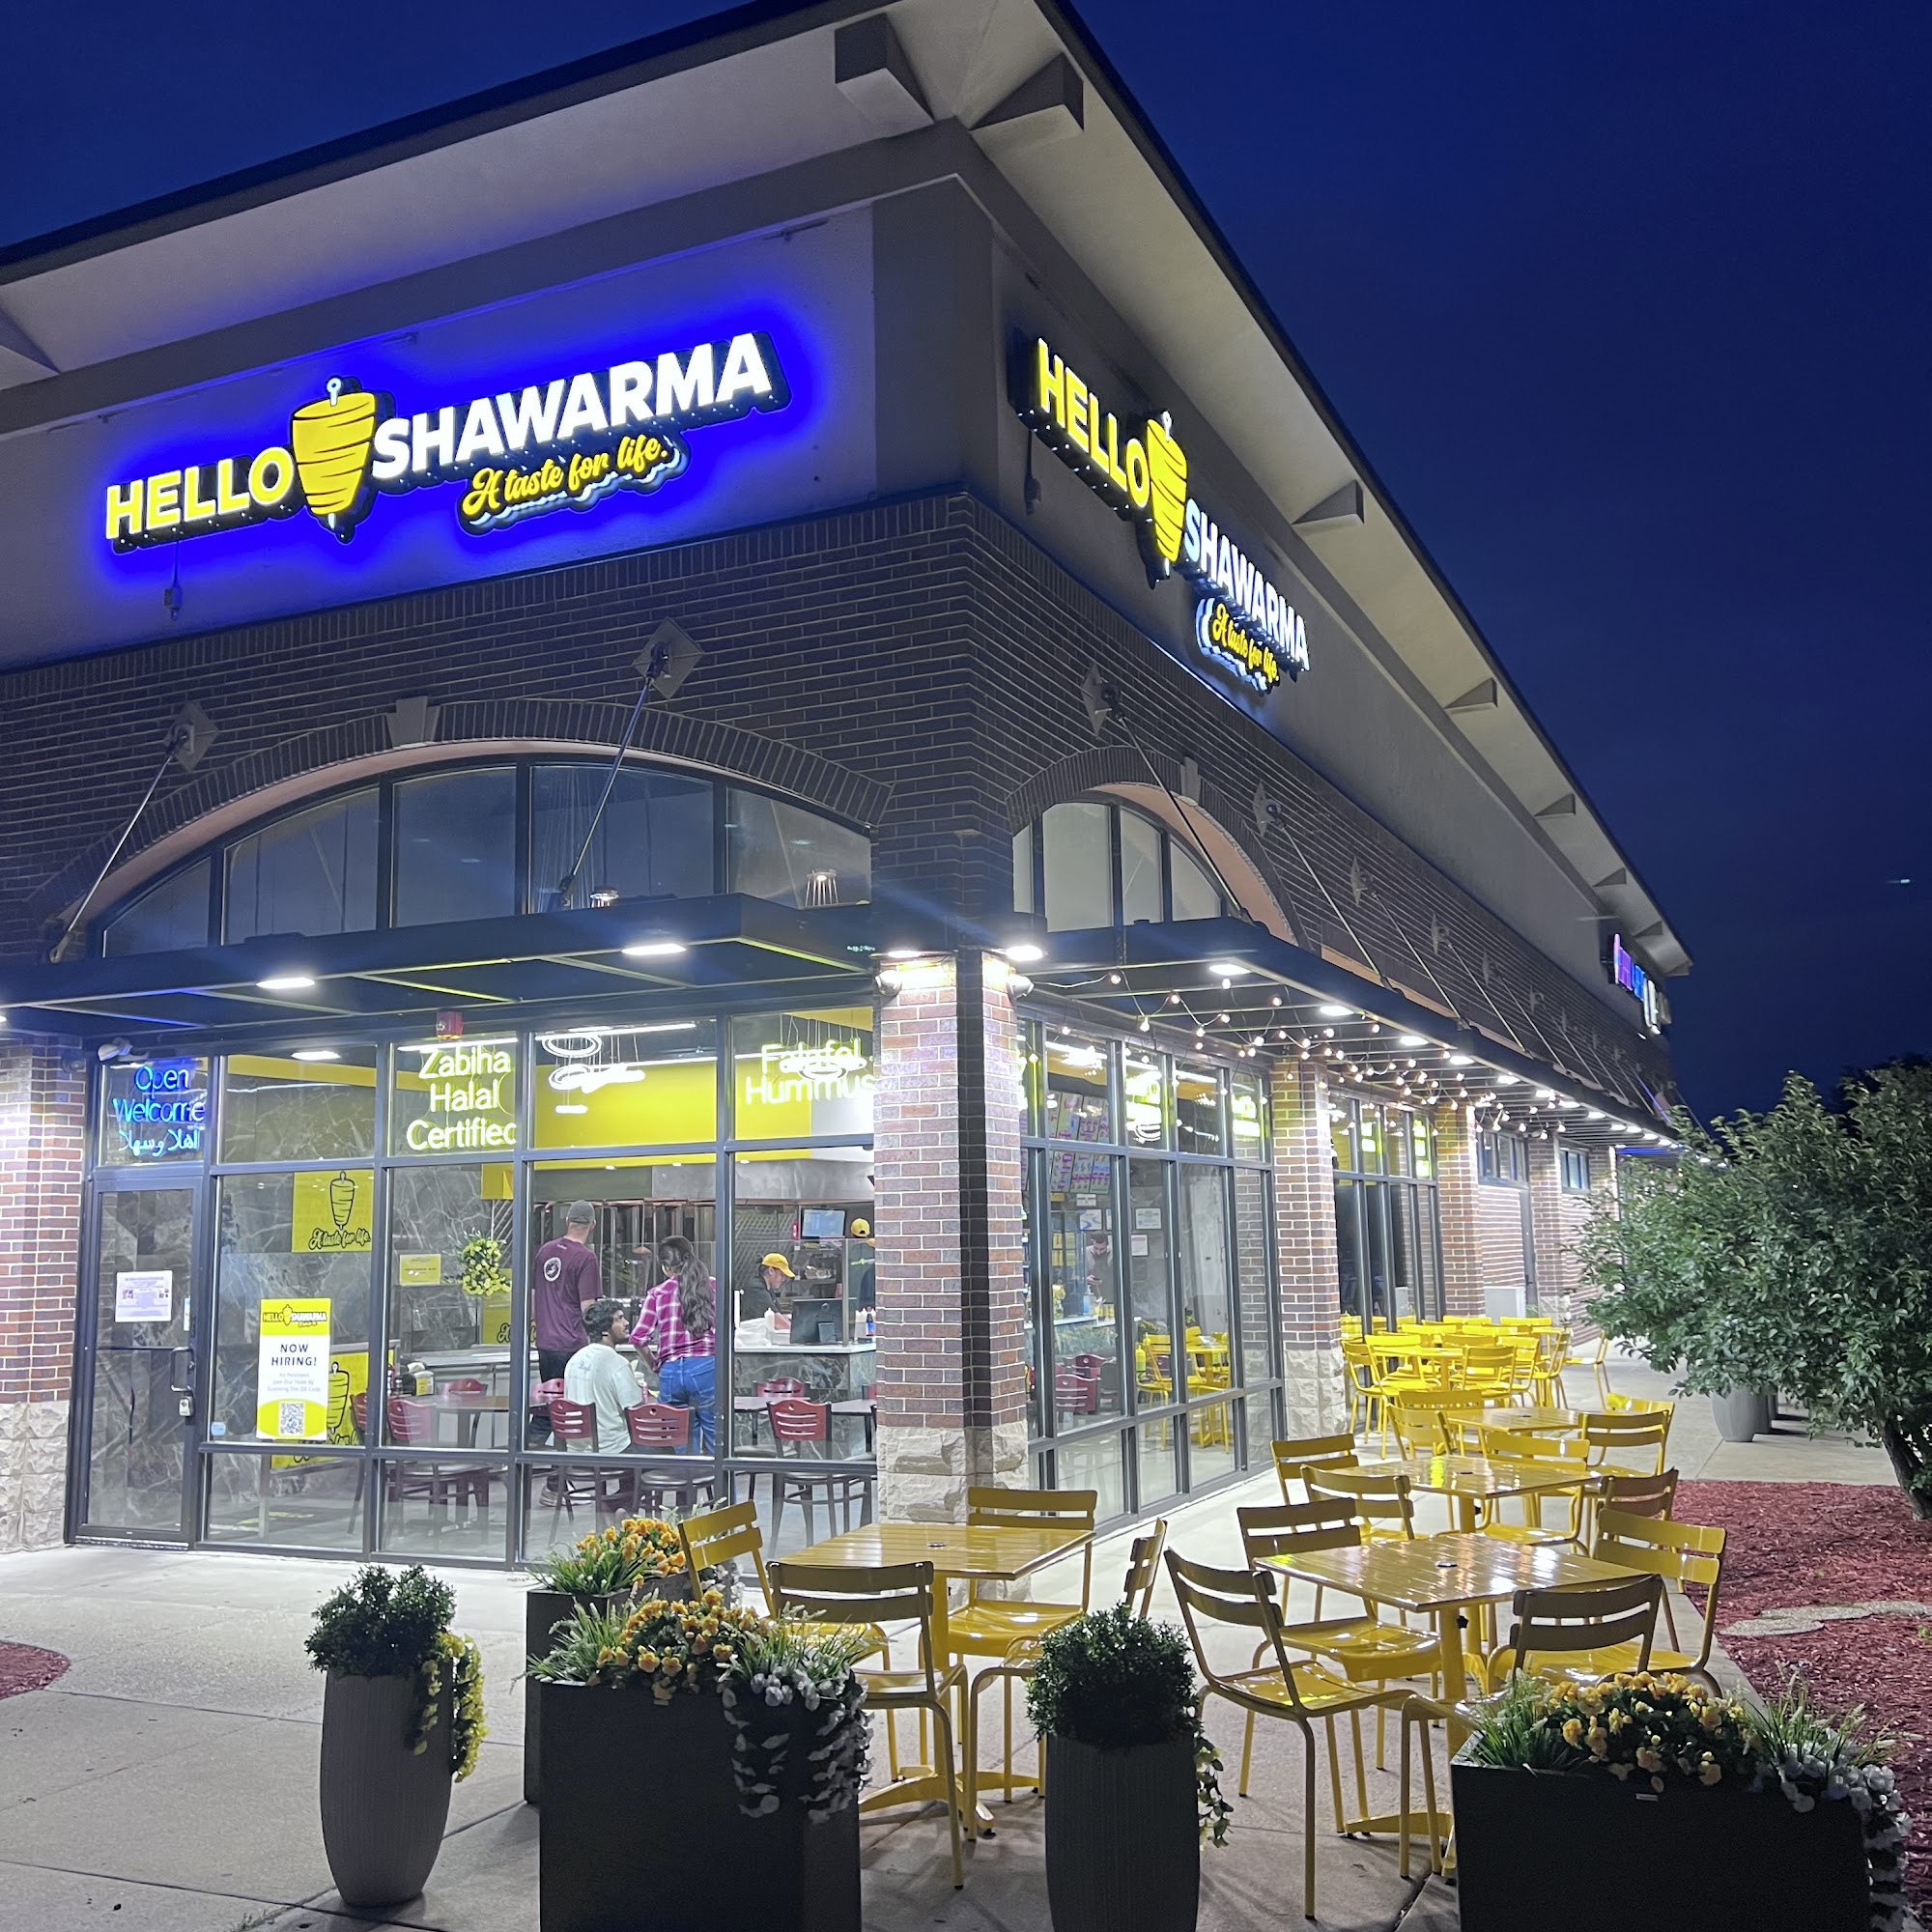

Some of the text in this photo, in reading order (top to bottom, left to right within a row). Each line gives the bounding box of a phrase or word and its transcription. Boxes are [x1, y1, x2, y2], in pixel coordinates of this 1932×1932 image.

[105, 331, 773, 540] HELLO SHAWARMA
[462, 434, 668, 516] A taste for life.
[1037, 337, 1311, 671] HELLO SHAWARMA
[418, 1045, 512, 1079] Zabiha
[135, 1065, 190, 1099] Open
[430, 1078, 499, 1112] Halal
[112, 1098, 206, 1122] Welcome
[263, 1312, 284, 1322] HELLO
[271, 1356, 317, 1366] HIRING!
[280, 1344, 308, 1352] NOW
